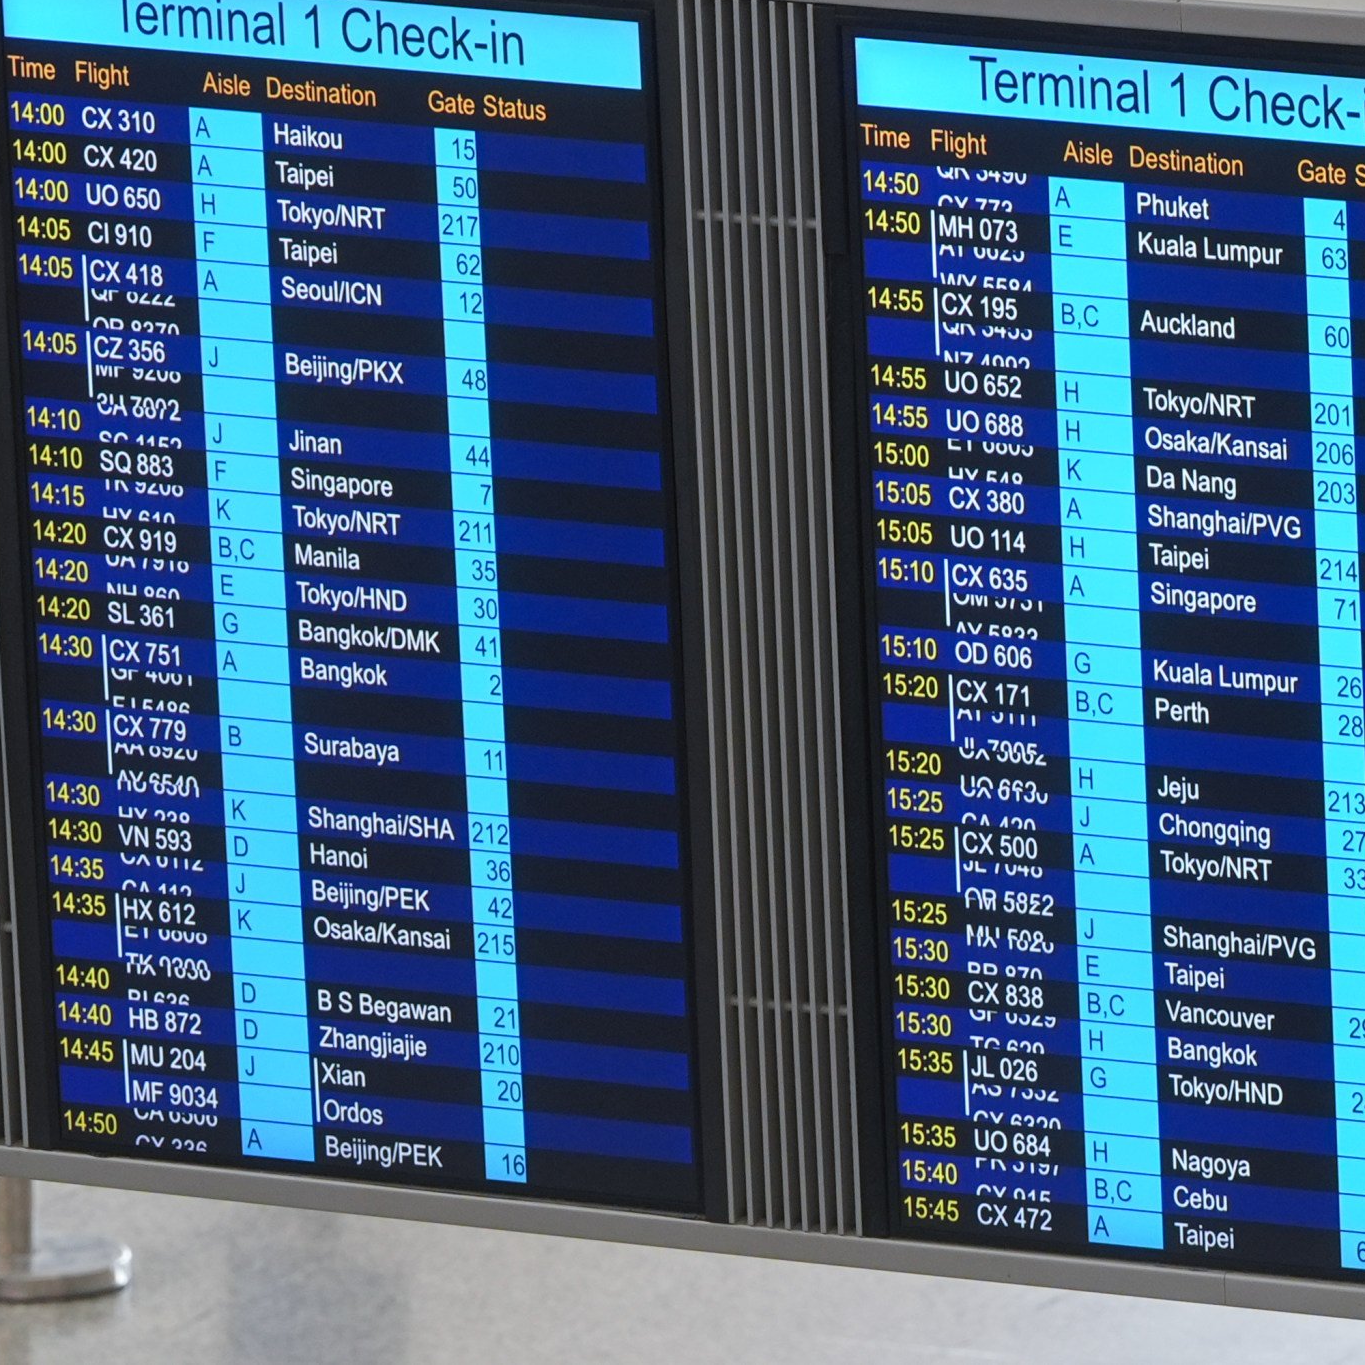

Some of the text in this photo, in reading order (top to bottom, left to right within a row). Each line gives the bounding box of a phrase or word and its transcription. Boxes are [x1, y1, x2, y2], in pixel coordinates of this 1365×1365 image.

[304, 3, 321, 50] 1
[340, 6, 525, 67] Check-in
[6, 53, 548, 123] Time Flight Aisle Destination Gate Status
[968, 54, 1150, 115] Terminal
[1169, 71, 1187, 118] 1
[12, 138, 478, 200] 14:00 CX 420 A Taipei 50
[859, 122, 912, 150] Time
[930, 128, 988, 161] Flight
[1062, 139, 1114, 167] Aisle
[1128, 144, 1245, 177] Destination
[1296, 158, 1347, 186] Gate
[275, 198, 387, 231] Tokyo/NRT
[1136, 191, 1211, 221] Phuket
[1139, 309, 1236, 340] Auckland
[284, 351, 405, 387] Beijing/PKX
[871, 401, 1355, 467] 14:55 UO 688 H Osaka/Kansai 206
[290, 465, 394, 501] Singapore
[1146, 464, 1238, 501] Da Nang
[32, 518, 499, 584] 14:20 CX 919 B,C Manila 35
[881, 633, 1363, 700] 15:10 OD 606 G Kuala Lumpur 26
[303, 731, 401, 767] Surabaya
[1158, 811, 1272, 851] Chongqing
[313, 915, 452, 951] Osaka/Kansai
[317, 988, 453, 1024] B S Begawan
[894, 972, 951, 1001] 15:30
[967, 979, 1000, 1006] CX
[1004, 983, 1045, 1010] 838
[1086, 990, 1126, 1019] B,C
[1164, 998, 1276, 1032] Vancouver
[318, 1024, 428, 1062] Zhangjiajie
[59, 1036, 524, 1104] 14:45 MU 204 J Xian 20
[1167, 1072, 1284, 1107] Tokyo/HND
[1171, 1147, 1252, 1182] Nagoya
